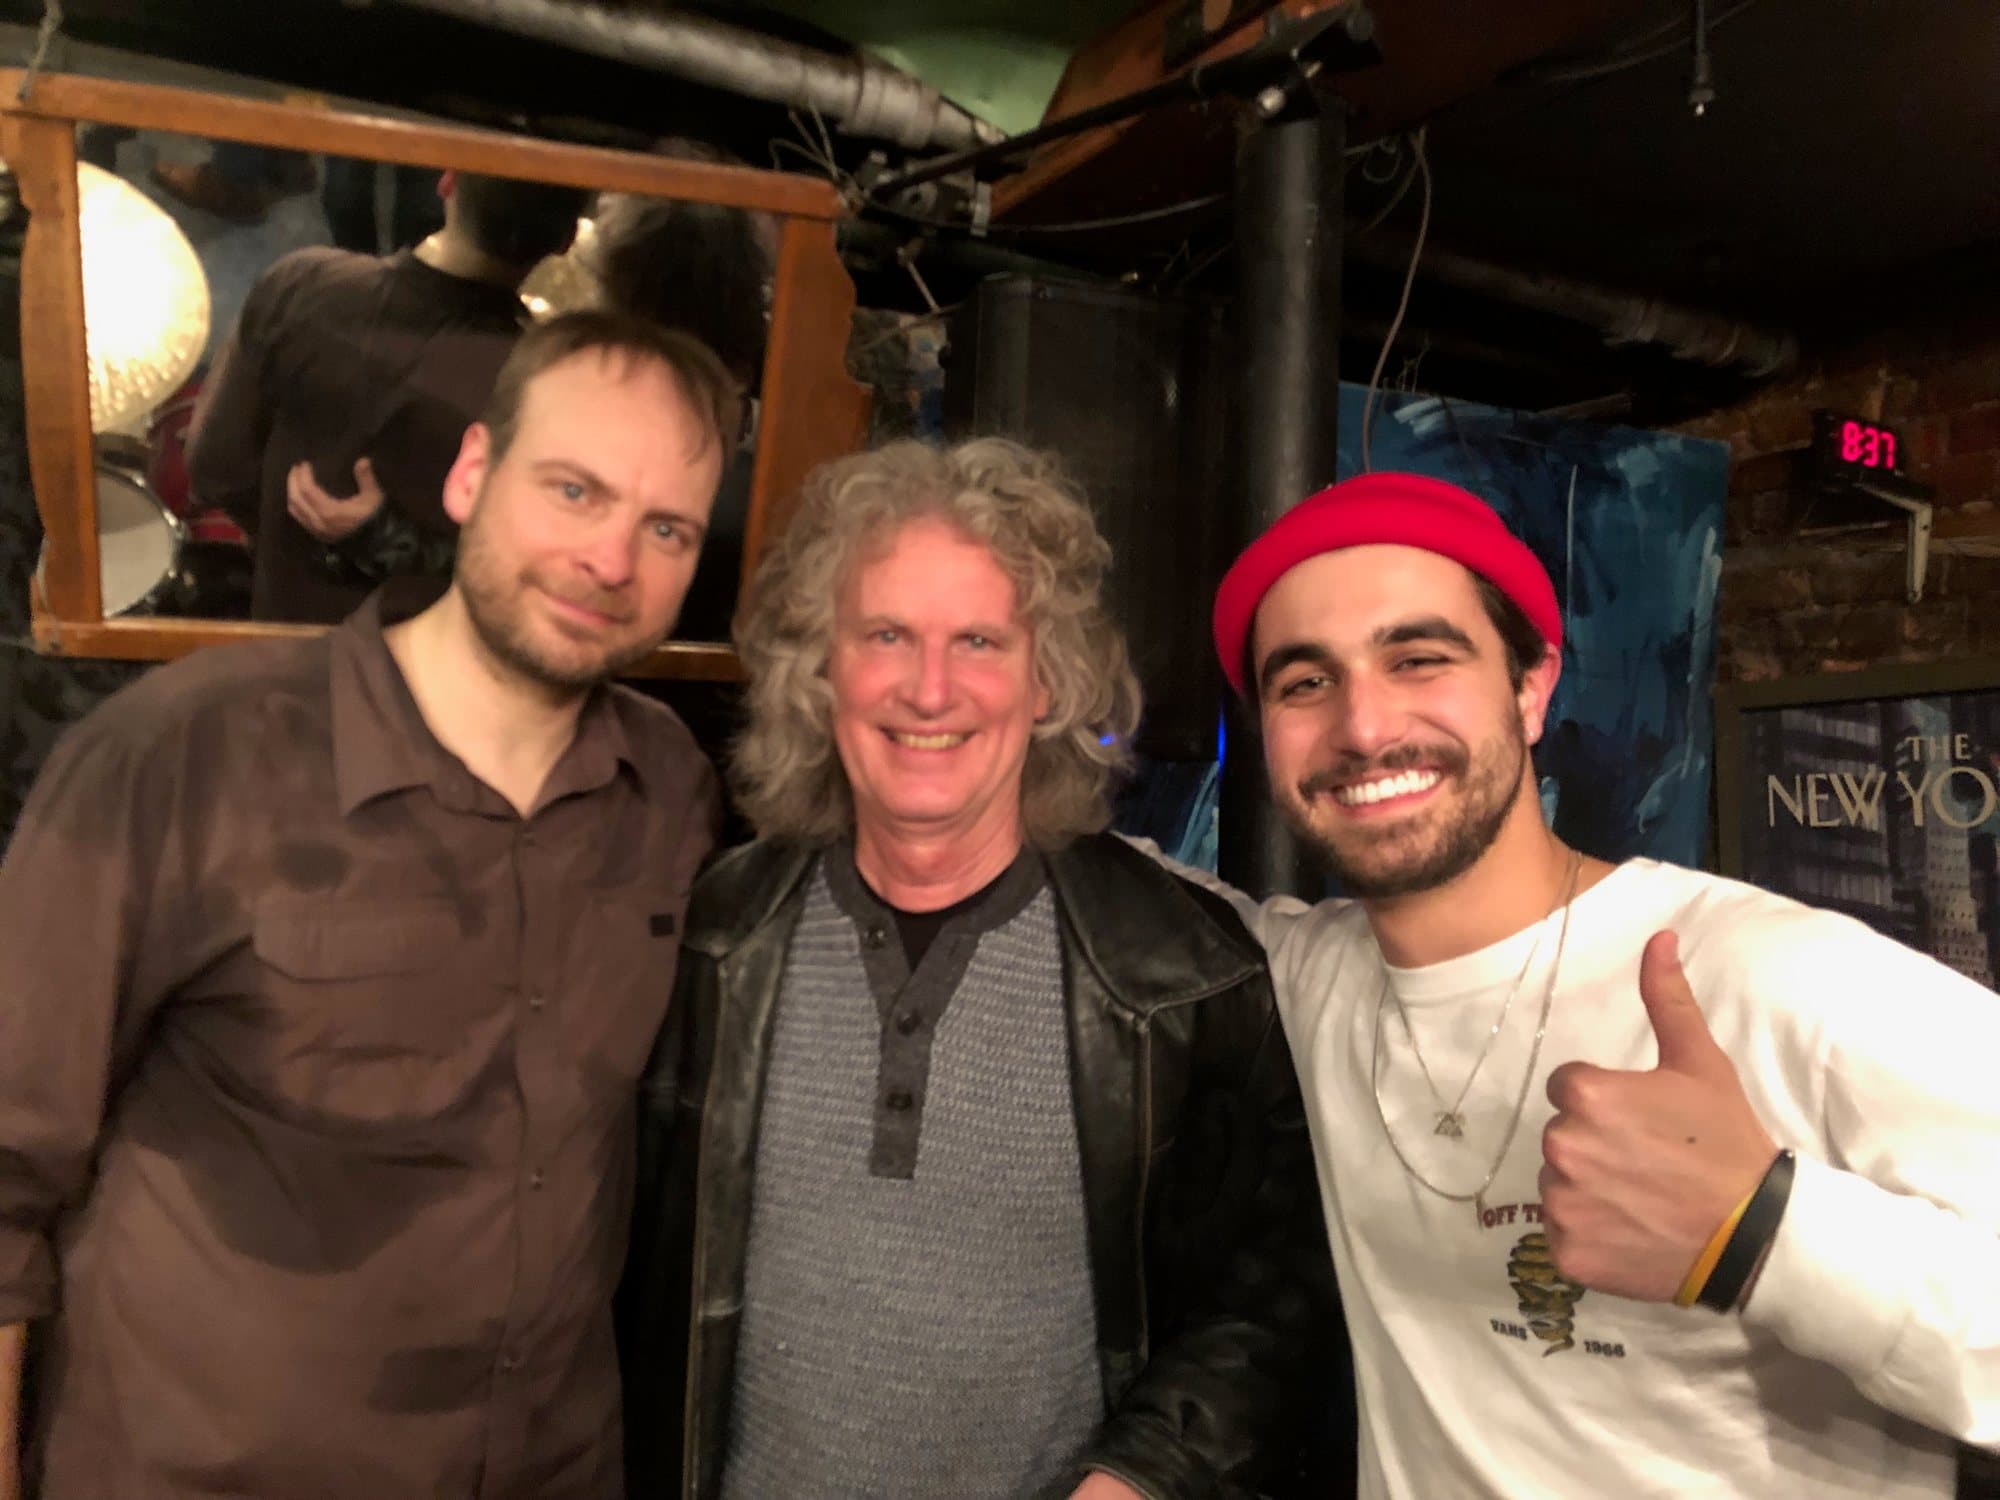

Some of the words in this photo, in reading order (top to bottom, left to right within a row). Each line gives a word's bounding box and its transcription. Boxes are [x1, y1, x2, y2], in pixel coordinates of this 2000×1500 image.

[1842, 420, 1895, 469] 8:37
[1906, 733, 1971, 760] THE
[1767, 764, 1887, 831] NEW
[1482, 1204, 1518, 1228] OFF
[1490, 1318, 1528, 1340] VANS
